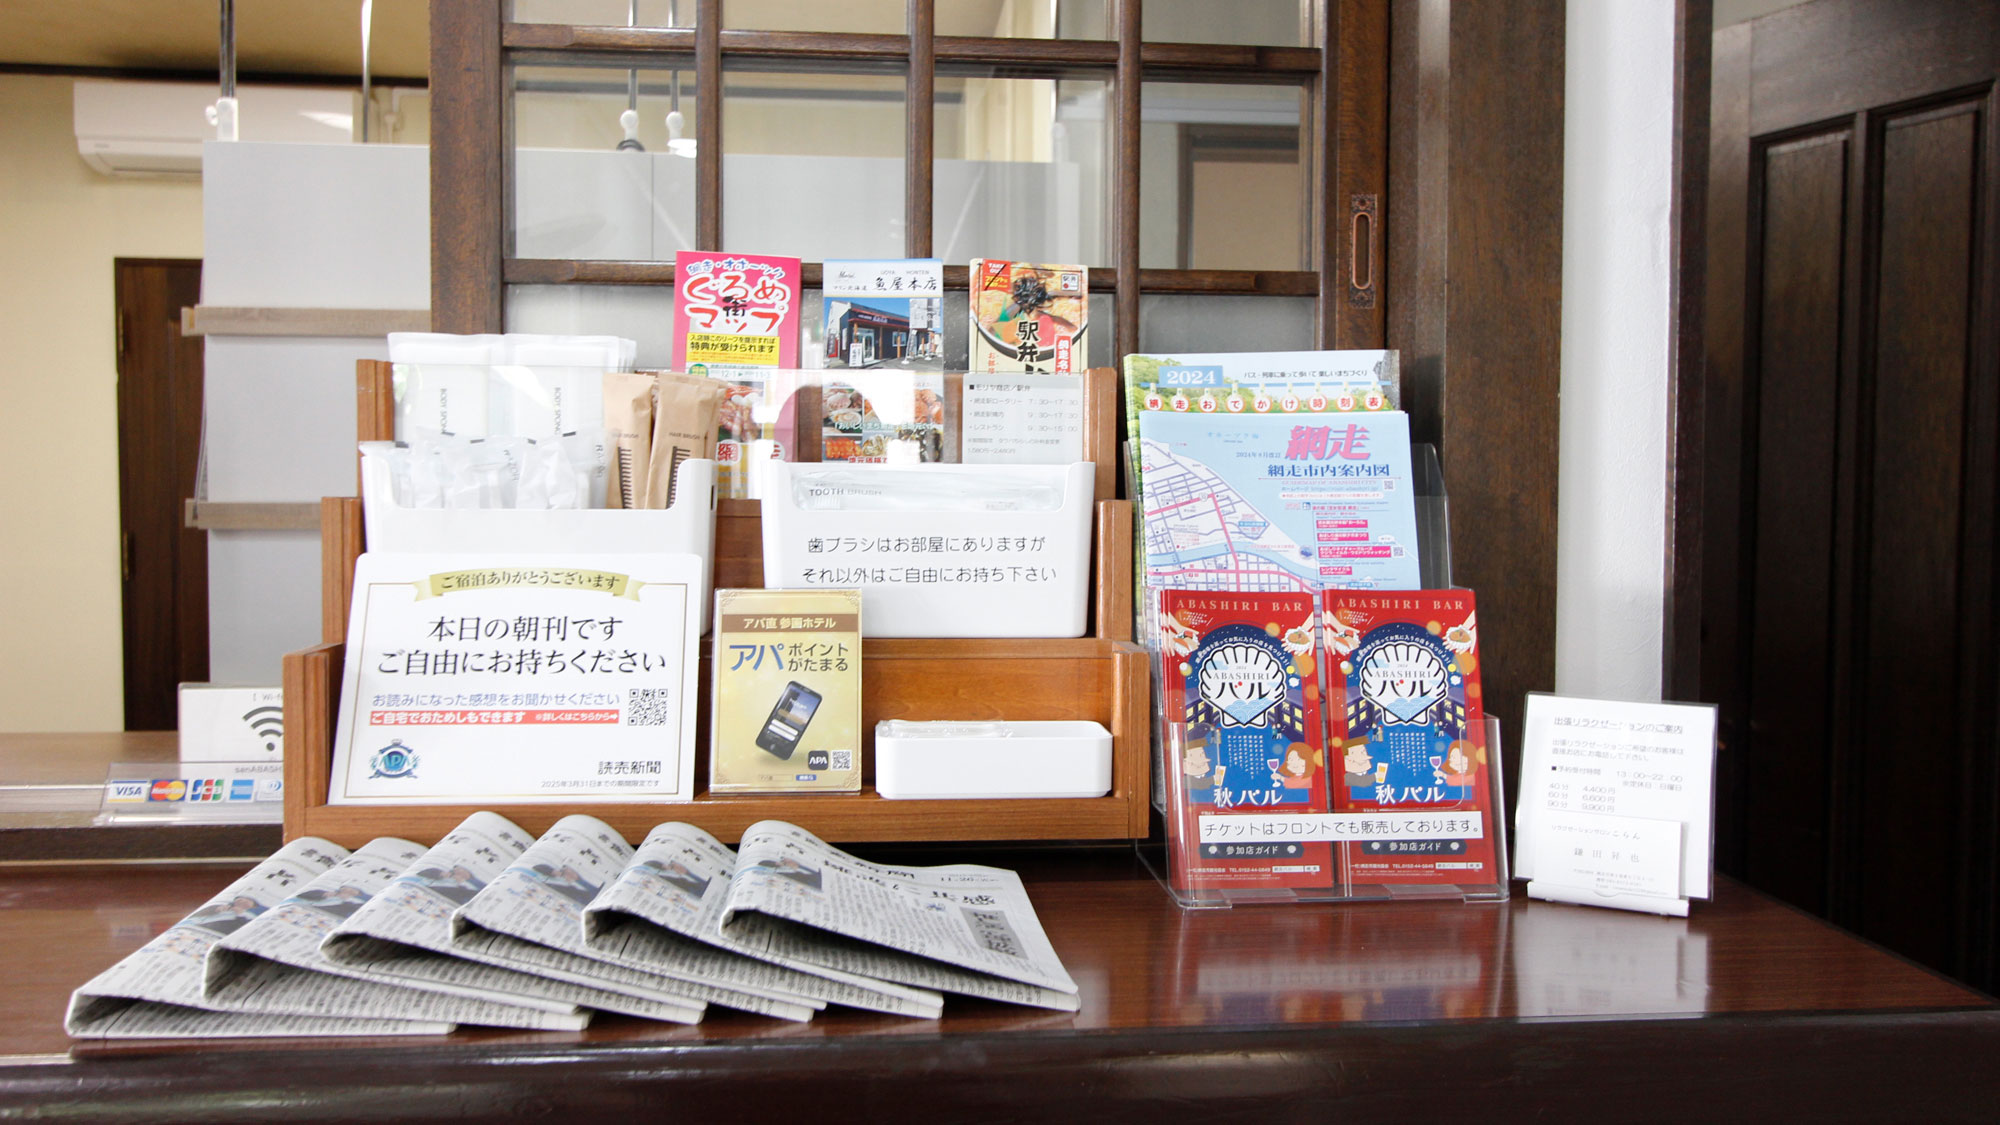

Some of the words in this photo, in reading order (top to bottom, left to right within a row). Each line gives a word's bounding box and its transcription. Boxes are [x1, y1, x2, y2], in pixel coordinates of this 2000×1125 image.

[873, 276, 937, 291] 魚屋本店
[722, 296, 748, 317] 街
[688, 304, 785, 333] マップ
[690, 341, 776, 353] 特典が受けられます
[1166, 370, 1217, 385] 2024
[440, 411, 448, 433] SPON
[1285, 423, 1372, 461] 網走
[1267, 463, 1390, 477] 網走市内案内図
[809, 487, 844, 497] TOOTH
[808, 536, 1046, 554] 歯ブラシはお部屋にありますが
[441, 570, 620, 591] ご宿泊ありがとうございます
[802, 566, 1057, 585] それ以外はご自由にお持ち下さい
[1176, 599, 1259, 611] ABASHIRI
[1272, 601, 1303, 612] BAR
[1337, 598, 1420, 610] ABASHIRI
[1433, 600, 1464, 610] BAR
[427, 615, 623, 642] 本日の朝刊です
[743, 617, 778, 630] アパ直
[779, 617, 836, 630] 参画ホテル
[377, 649, 666, 677] ご自由にお持ちください
[729, 642, 785, 672] アパ
[788, 642, 849, 657] ポイント
[788, 657, 849, 672] がたまる
[1213, 672, 1270, 680] ABASHIRI
[1374, 670, 1431, 679] ABASHIRI
[1214, 681, 1272, 700] バル
[1376, 679, 1433, 698] バル
[372, 692, 620, 708] お読みになった感想をお聞かせください
[371, 710, 525, 725] ご自宅でおためしもできます
[597, 760, 662, 776] 読売新聞
[808, 755, 828, 766] APA
[1559, 765, 1601, 776] 予約受付時間
[115, 786, 142, 796] VISA
[541, 780, 661, 789] 2025年3月31日までの期間限定です
[1213, 787, 1283, 808] 秋バル
[1375, 784, 1446, 805] 秋バル
[1204, 819, 1479, 837] チケットはフロントでも販売しております。
[1226, 845, 1279, 855] 参加店ガイド
[1389, 842, 1441, 851] 参加店ガイド
